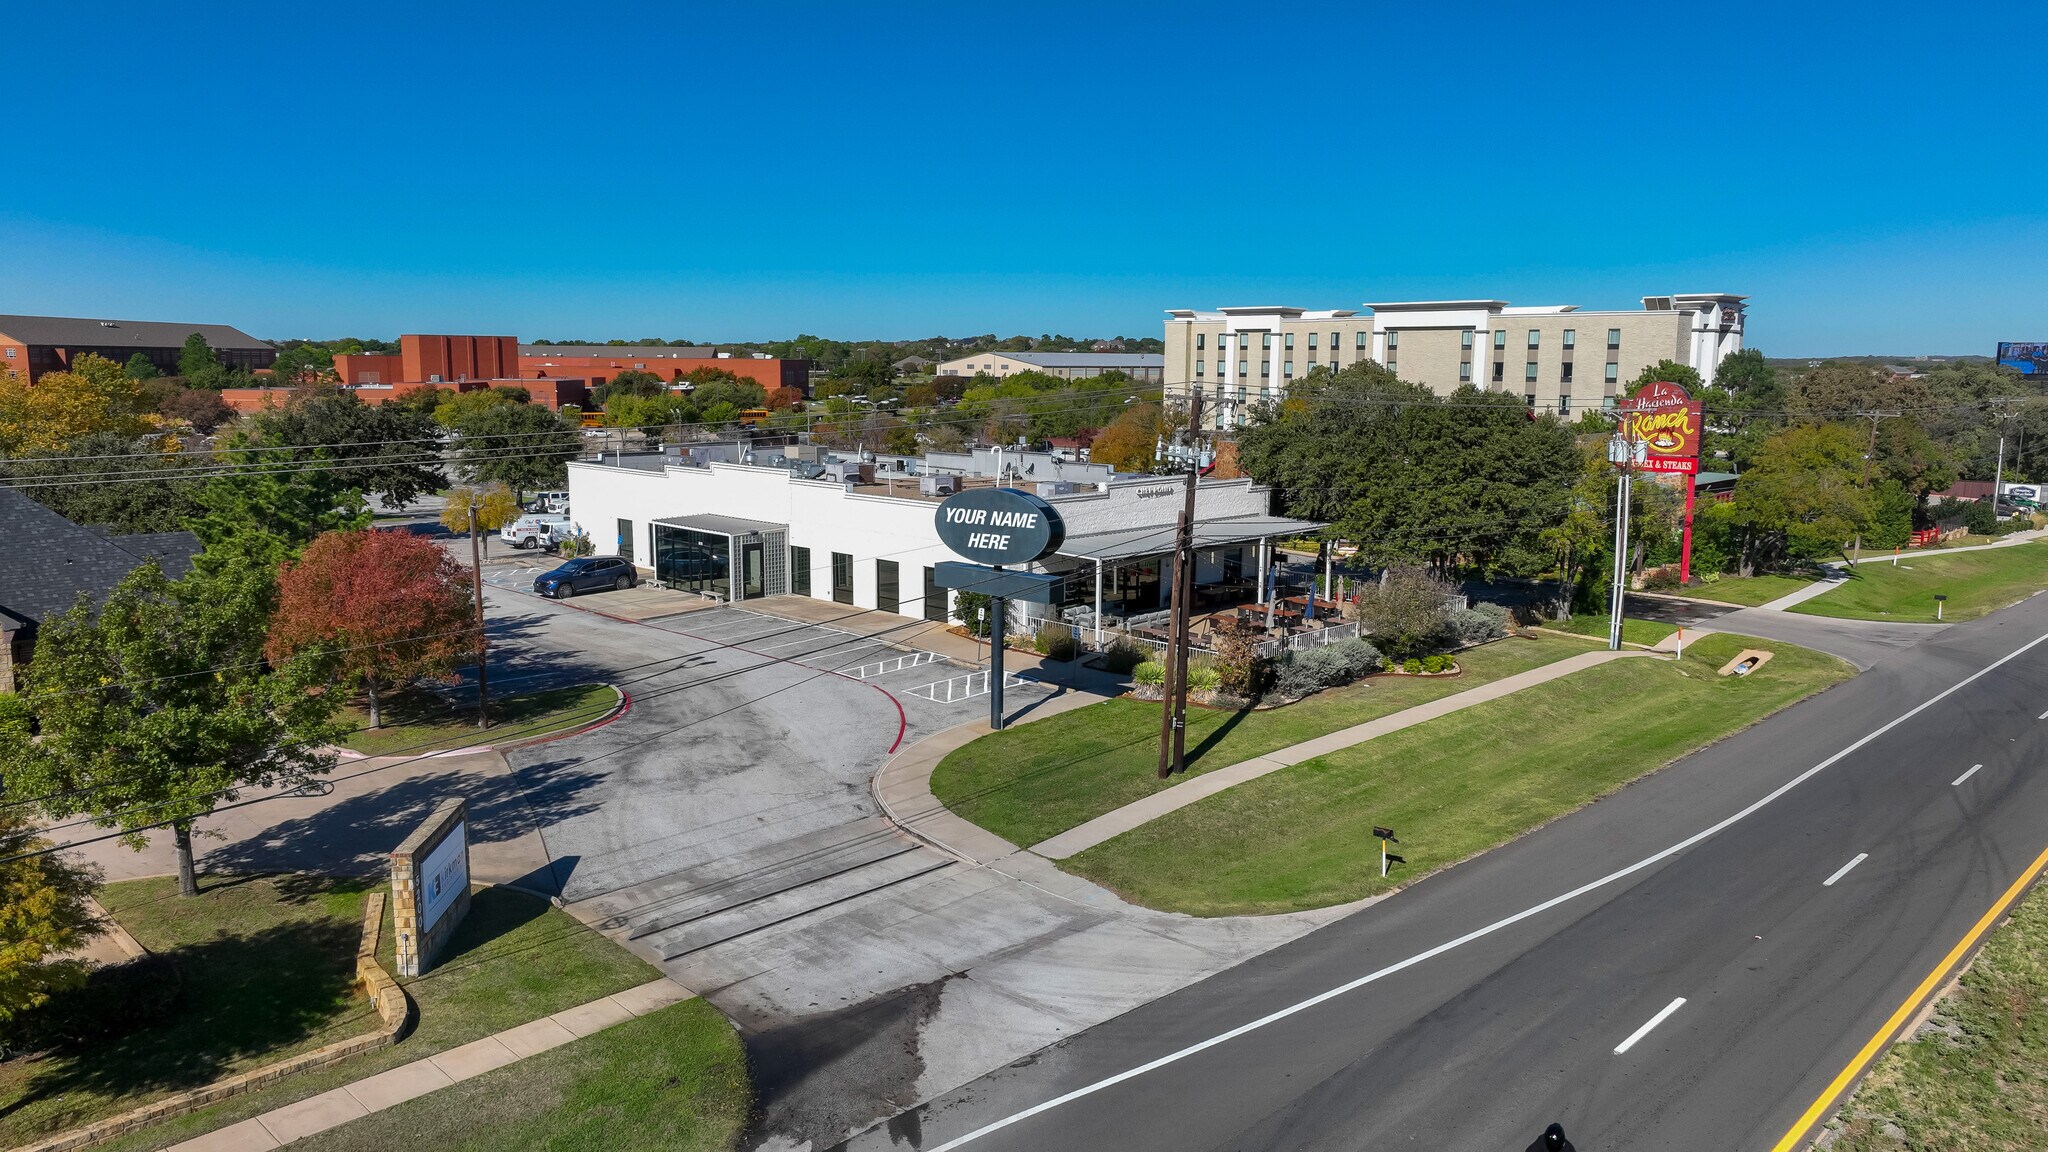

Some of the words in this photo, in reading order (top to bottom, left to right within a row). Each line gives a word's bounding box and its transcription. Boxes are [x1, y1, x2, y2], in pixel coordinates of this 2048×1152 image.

[1653, 384, 1668, 397] La
[1636, 395, 1683, 409] Hacienda
[1623, 407, 1694, 445] Ranch
[1655, 461, 1661, 469] &
[1663, 460, 1692, 470] STEAKS
[946, 507, 987, 525] YOUR
[990, 511, 1038, 529] NAME
[968, 532, 1010, 550] HERE
[415, 874, 423, 928] 5200
